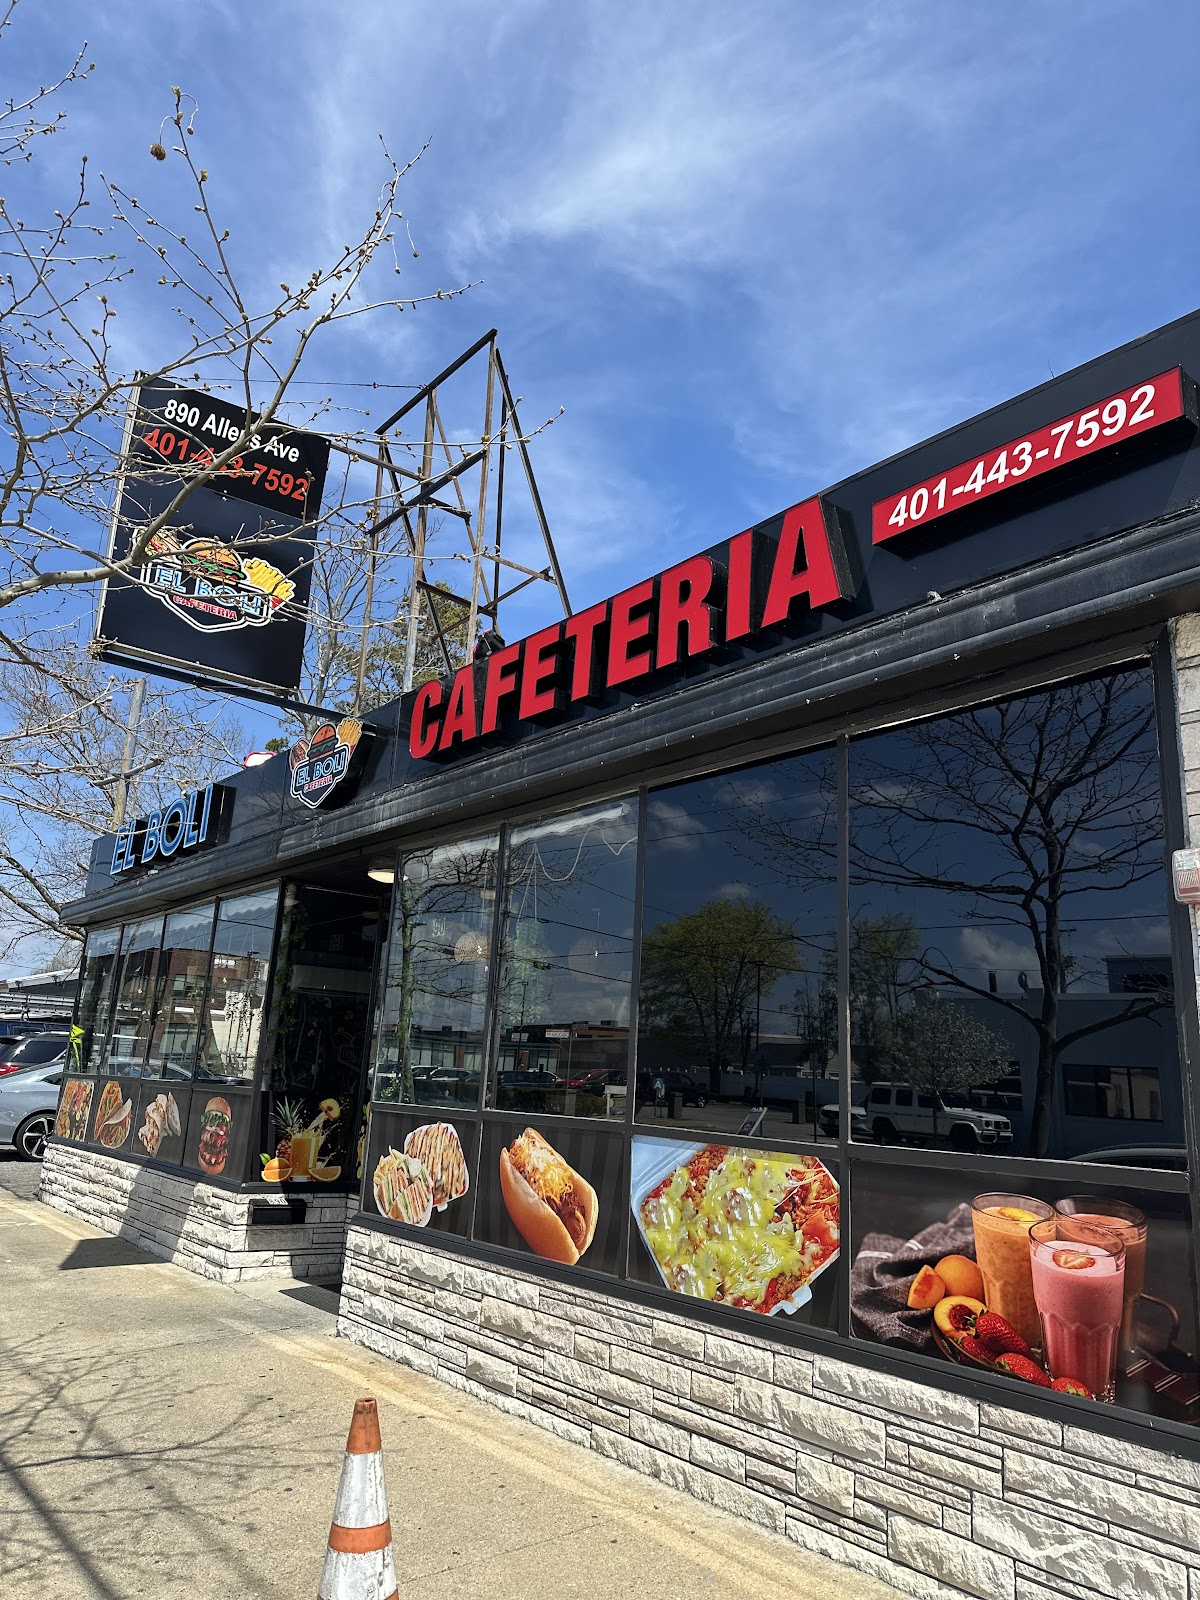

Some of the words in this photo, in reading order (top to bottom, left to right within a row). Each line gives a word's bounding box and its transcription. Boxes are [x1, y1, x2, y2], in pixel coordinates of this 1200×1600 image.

[164, 399, 200, 427] 890
[201, 413, 261, 450] Alles
[263, 435, 300, 463] Ave
[887, 384, 1156, 528] 401-443-7592
[156, 565, 187, 593] EL
[172, 594, 238, 620] CAFETERIA
[408, 496, 842, 760] CAFETERIA
[296, 765, 310, 787] EL
[313, 751, 346, 780] BOLI
[303, 774, 333, 793] CAFETERIA
[110, 819, 137, 875] EL
[141, 784, 213, 864] BOLI
